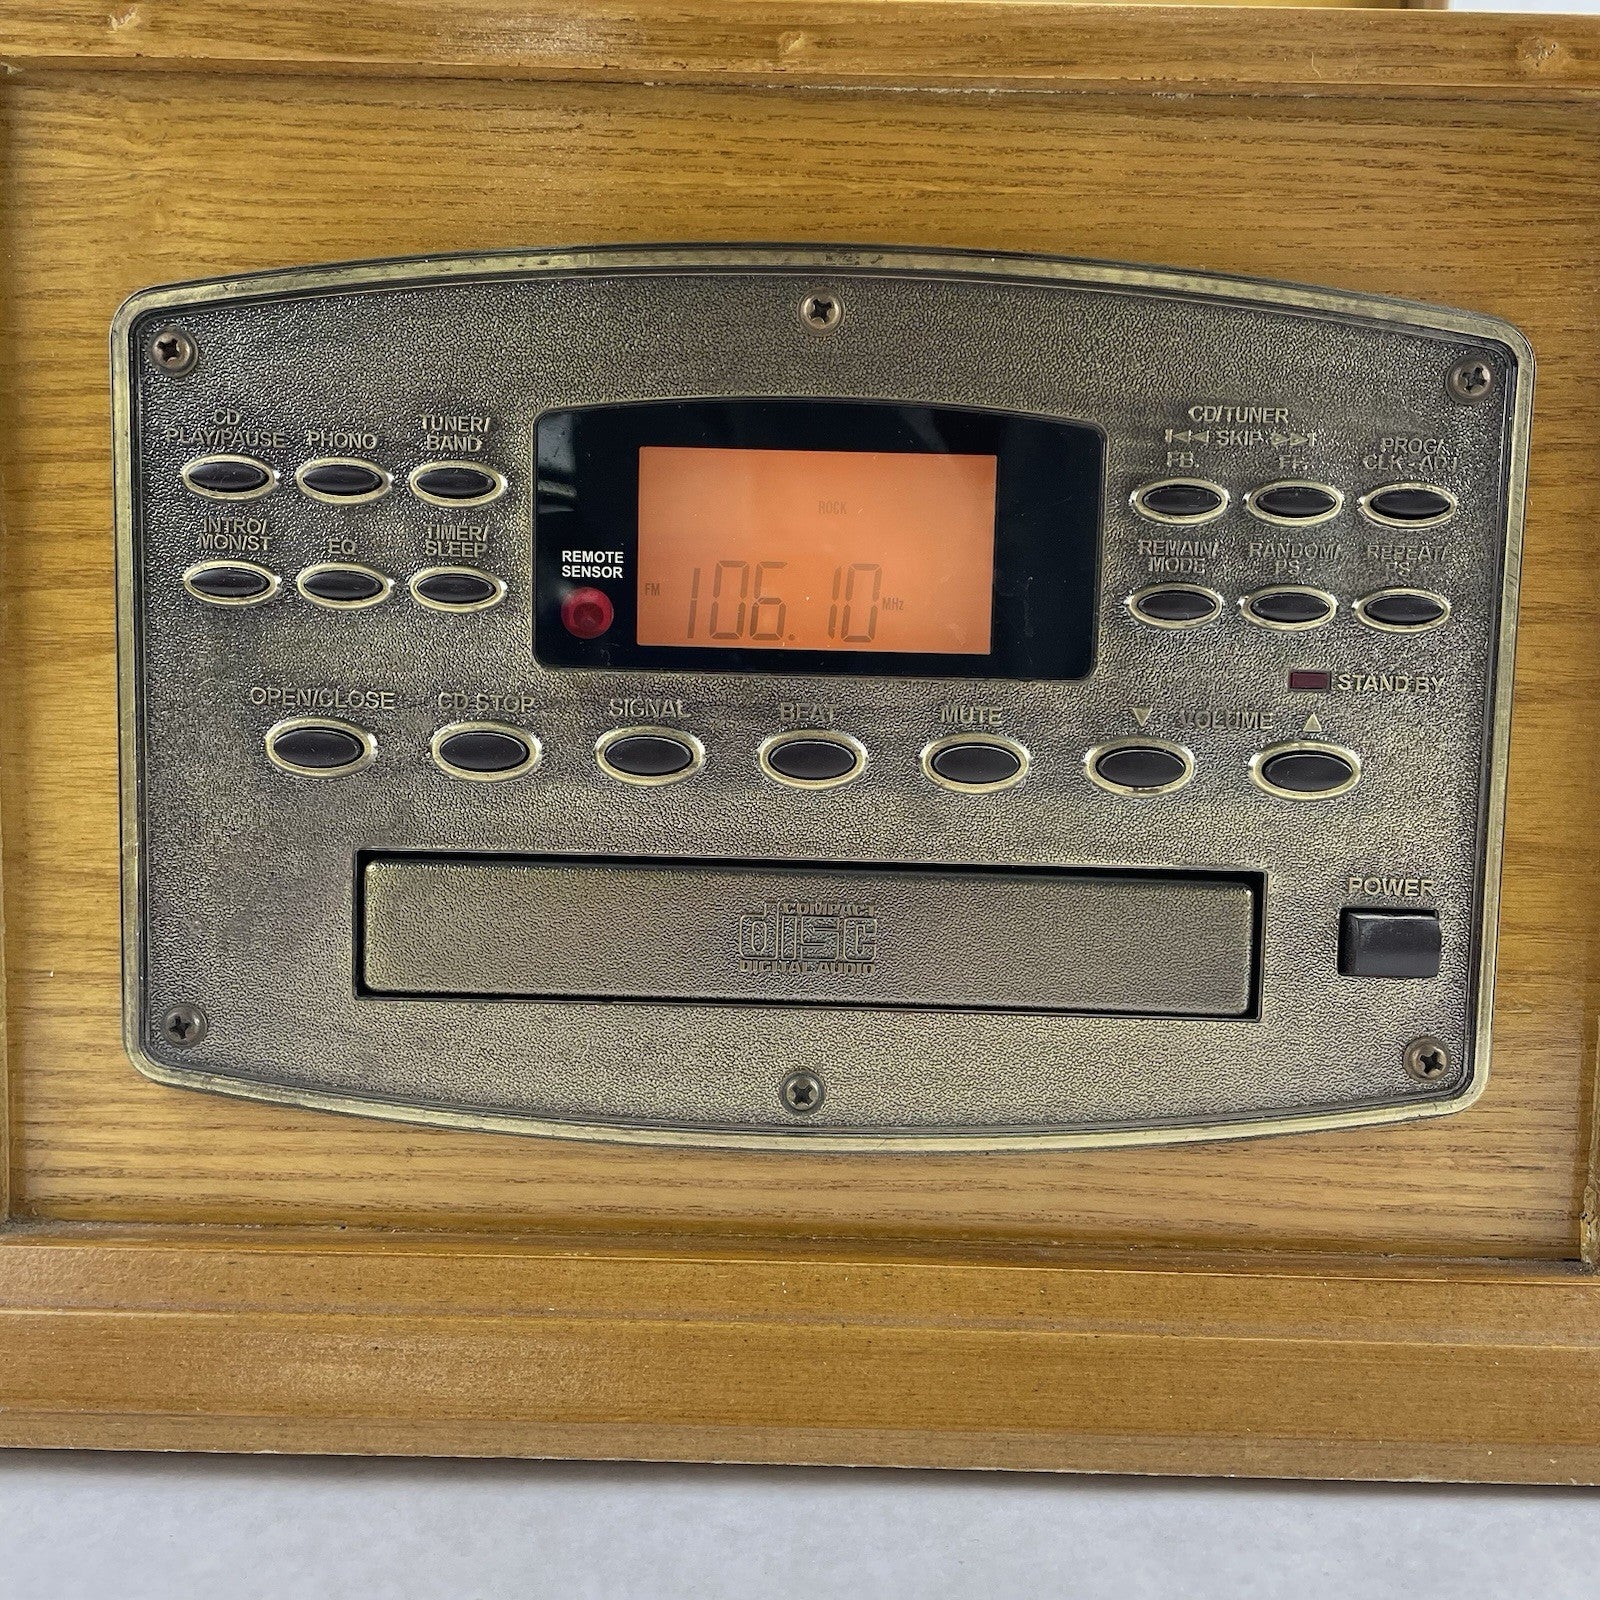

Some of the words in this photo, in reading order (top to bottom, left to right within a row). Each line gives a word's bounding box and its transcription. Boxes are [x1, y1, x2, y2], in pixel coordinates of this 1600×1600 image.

[213, 409, 240, 425] CD
[1189, 405, 1289, 424] CD/TUNER
[421, 415, 490, 432] TUNER/
[166, 429, 287, 448] PLAY/PAUSE
[308, 432, 378, 449] PHONO
[426, 435, 483, 452] BAND
[1216, 429, 1262, 446] SKIP
[818, 501, 847, 515] ROCK
[202, 516, 268, 535] INTRO/
[425, 524, 489, 541] TIMER/
[199, 533, 273, 551] MON/ST
[328, 540, 358, 556] EQ
[425, 540, 488, 558] SLEEP
[562, 550, 624, 564] REMOTE
[1149, 557, 1205, 574] MODE
[561, 565, 623, 579] SENSOR
[644, 583, 661, 597] FM
[882, 597, 904, 611] MHz
[250, 687, 396, 711] OPEN/CLOSE
[438, 692, 468, 711] CD
[475, 694, 536, 713] STOP
[609, 699, 691, 719] SIGNAL
[779, 703, 838, 722] BEAT
[941, 706, 1004, 726] MUTE
[1180, 710, 1273, 729] VOLUME
[1348, 877, 1434, 897] POWER
[780, 902, 876, 916] COMPACT
[739, 960, 811, 973] DIGITAL
[817, 962, 876, 975] AUDIO
